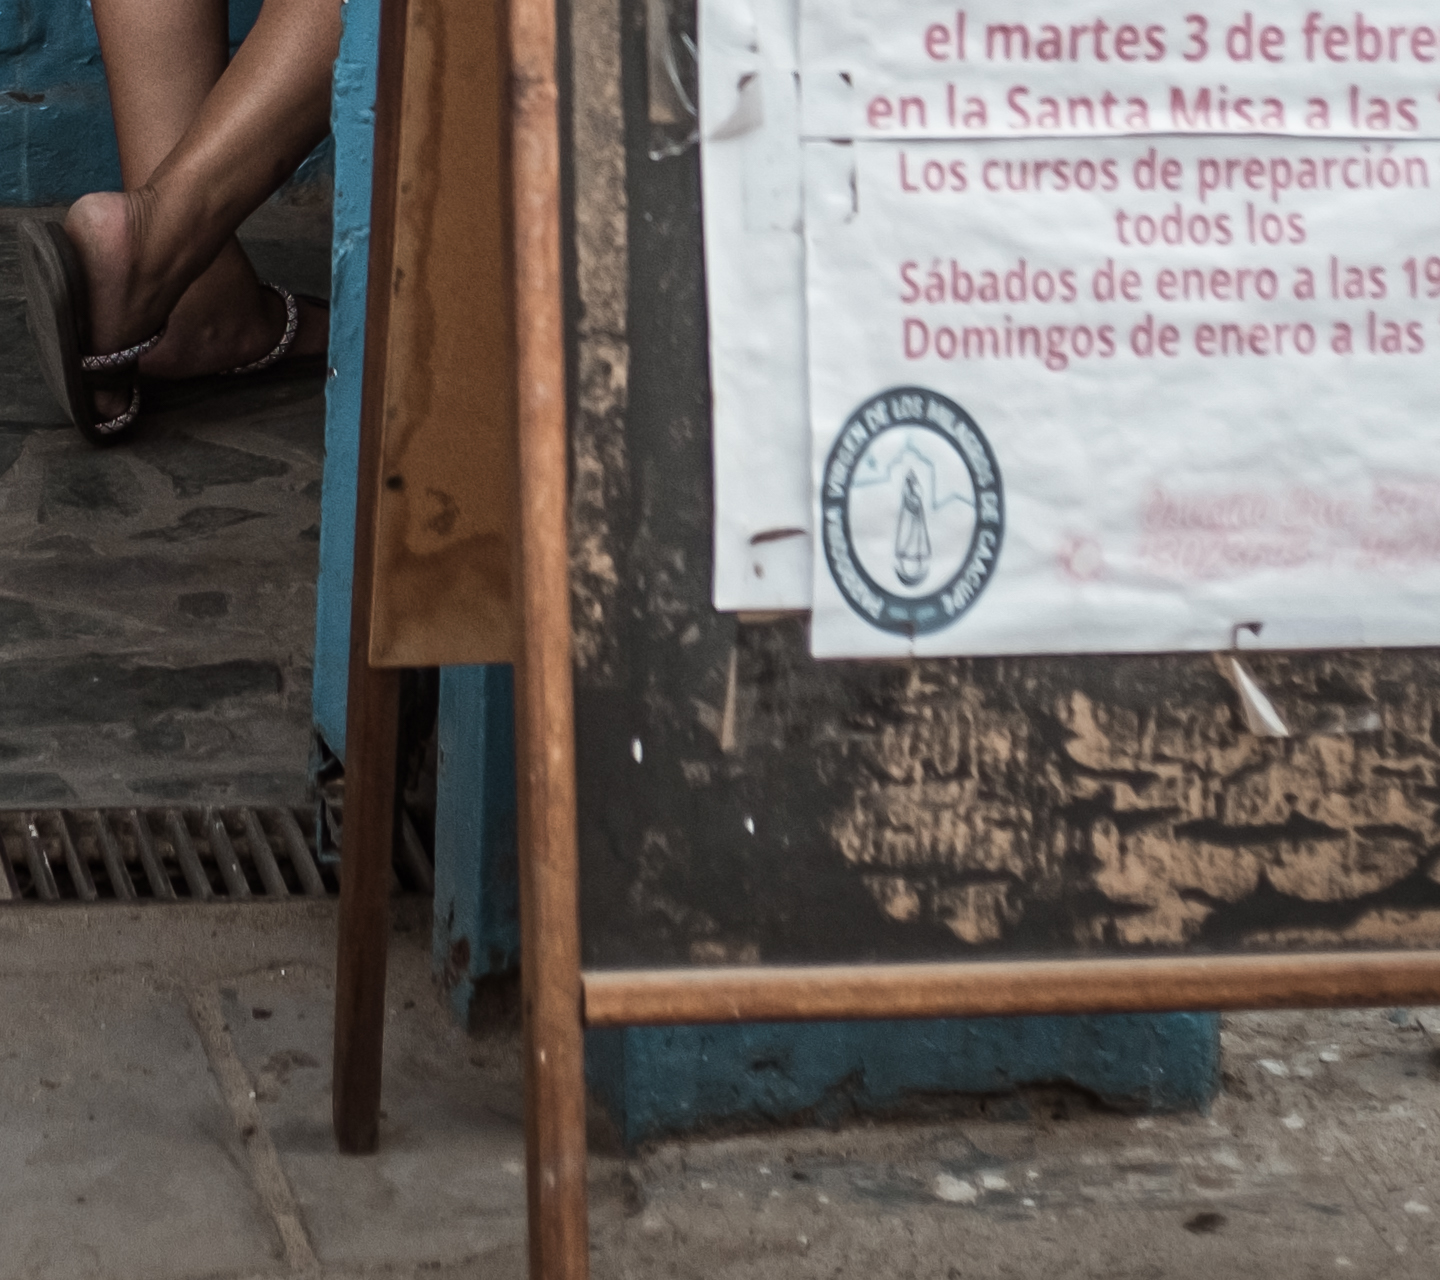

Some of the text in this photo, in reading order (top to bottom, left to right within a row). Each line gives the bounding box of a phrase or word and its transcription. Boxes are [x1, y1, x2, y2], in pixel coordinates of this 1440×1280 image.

[924, 9, 967, 63] el
[984, 18, 1168, 65] martes
[1184, 14, 1209, 63] 3
[1226, 12, 1282, 65] de
[866, 91, 928, 132] en
[944, 86, 988, 132] la
[1006, 84, 1149, 132] Santa
[1168, 84, 1286, 132] Misa
[1306, 95, 1331, 132] a
[1349, 86, 1419, 134] las
[898, 151, 967, 194] Los
[980, 157, 1115, 194] cursos
[1132, 149, 1181, 194] de
[1196, 148, 1428, 202] preparción
[1115, 202, 1306, 247] todos los
[899, 258, 1078, 305] Sábados
[1092, 260, 1143, 303] de
[1156, 264, 1278, 301] enero
[1293, 266, 1316, 299] a
[1331, 258, 1389, 299] las
[903, 314, 1115, 371] Domingos
[1130, 312, 1181, 359] de
[1194, 320, 1316, 359] enero
[1331, 318, 1353, 356] a
[1366, 311, 1424, 356] las
